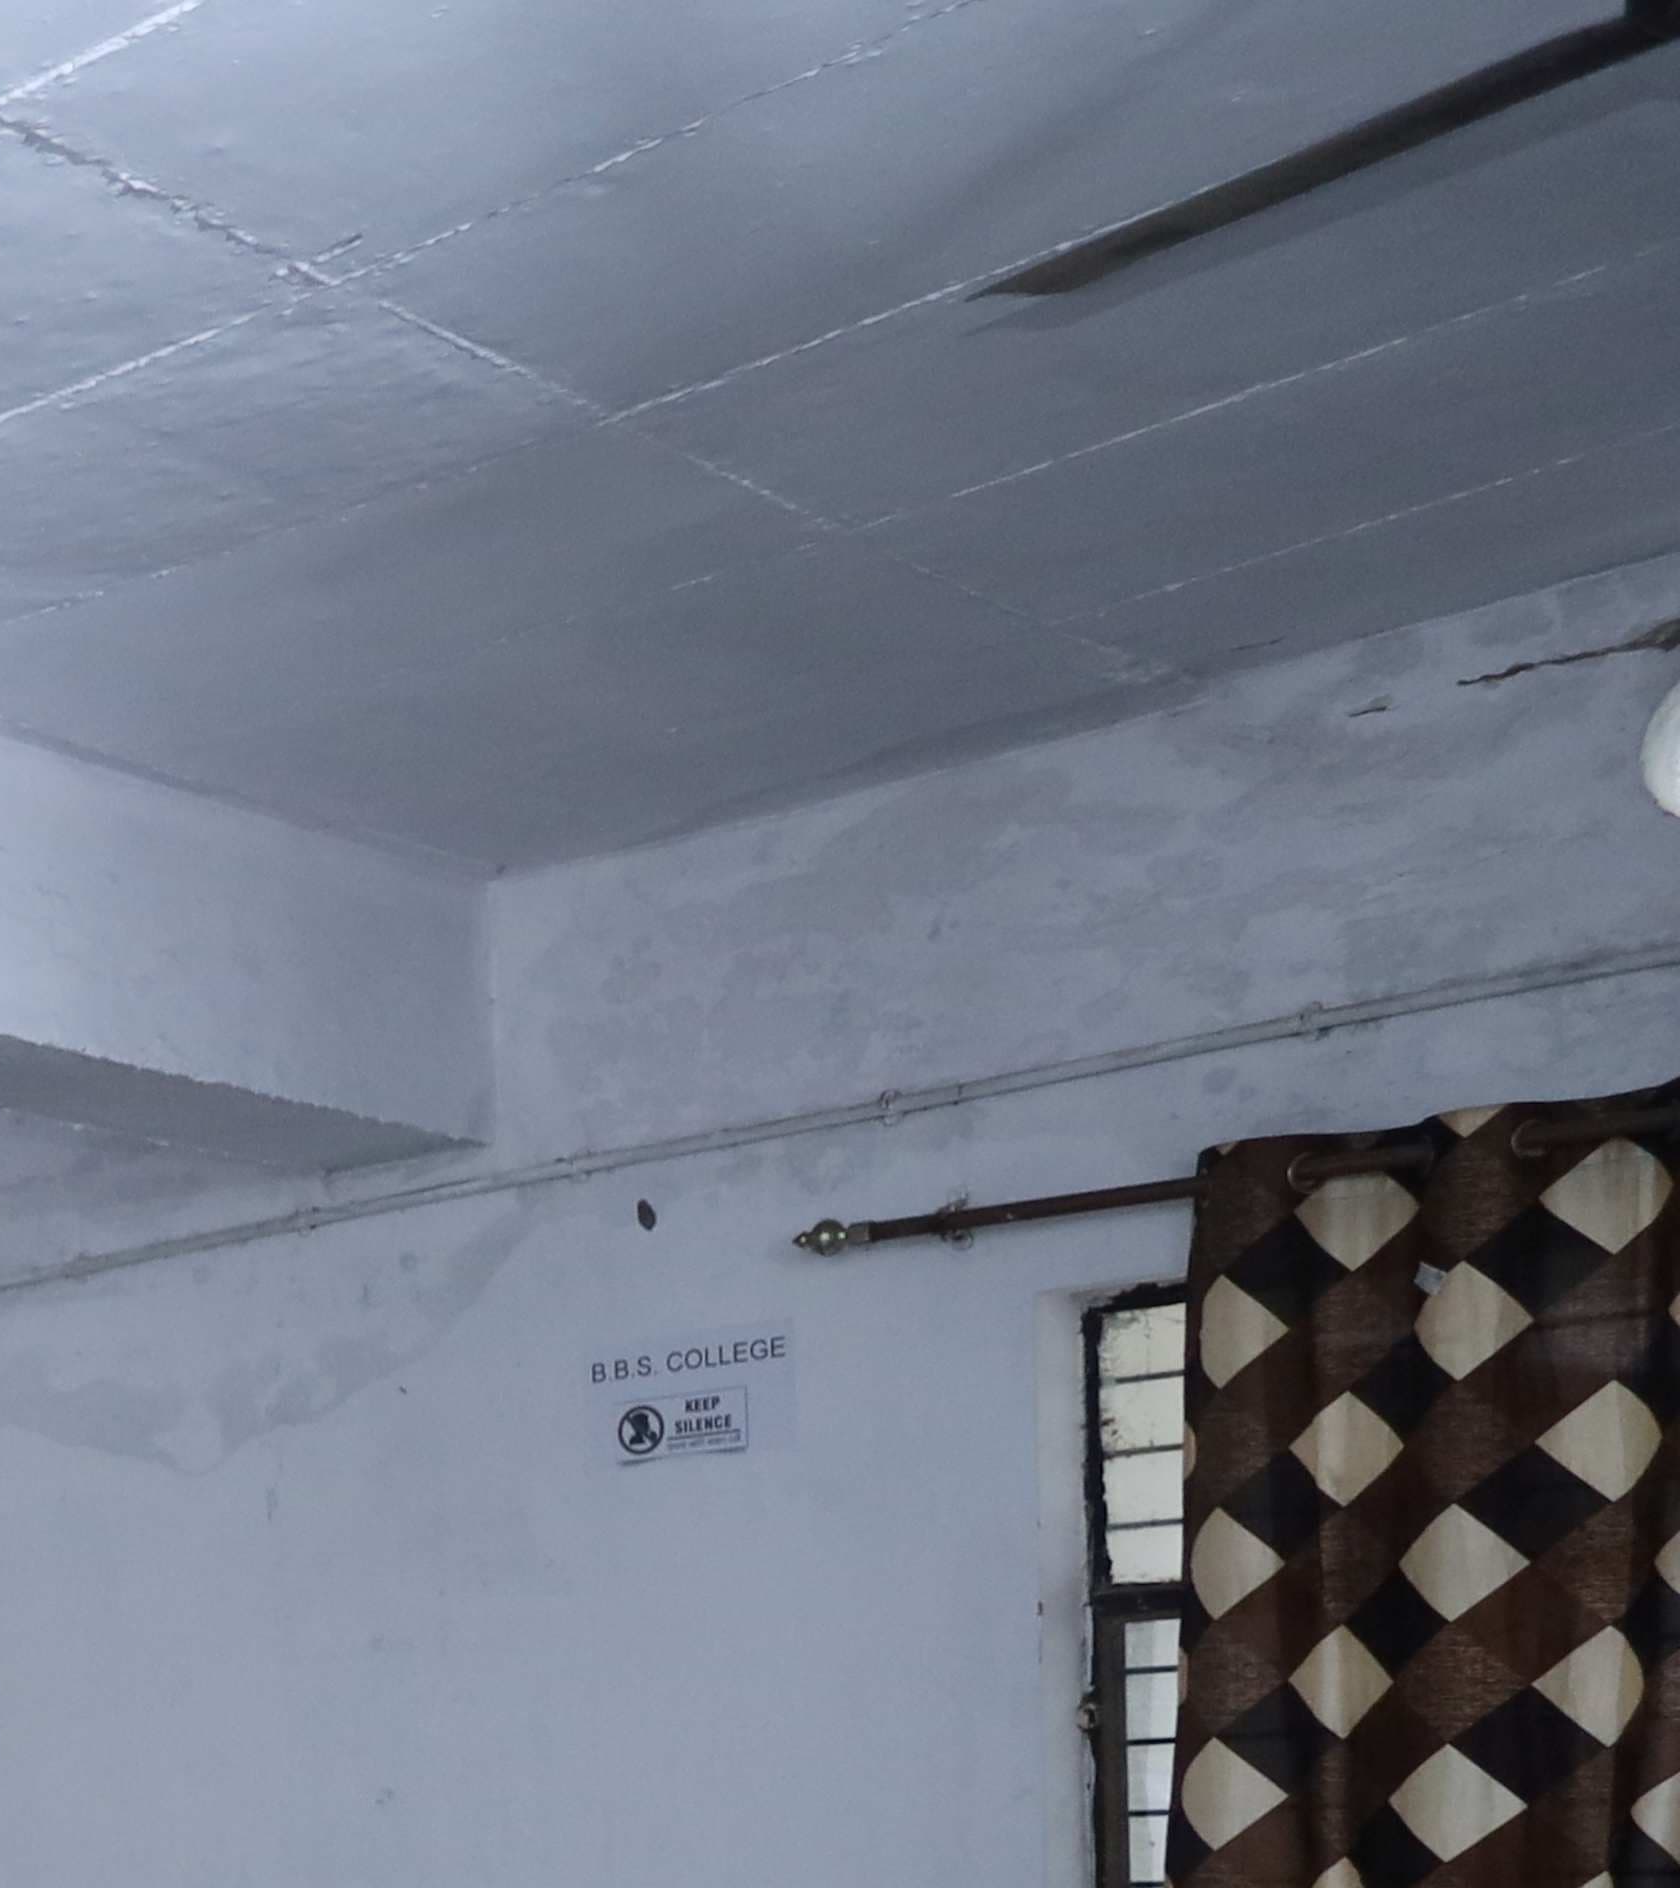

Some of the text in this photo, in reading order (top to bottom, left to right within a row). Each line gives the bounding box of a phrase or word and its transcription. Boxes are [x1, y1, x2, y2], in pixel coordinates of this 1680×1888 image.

[591, 1336, 786, 1384] B.B.S. COLLEGE
[684, 1395, 721, 1414] KEEP
[674, 1414, 733, 1435] SILENCE
